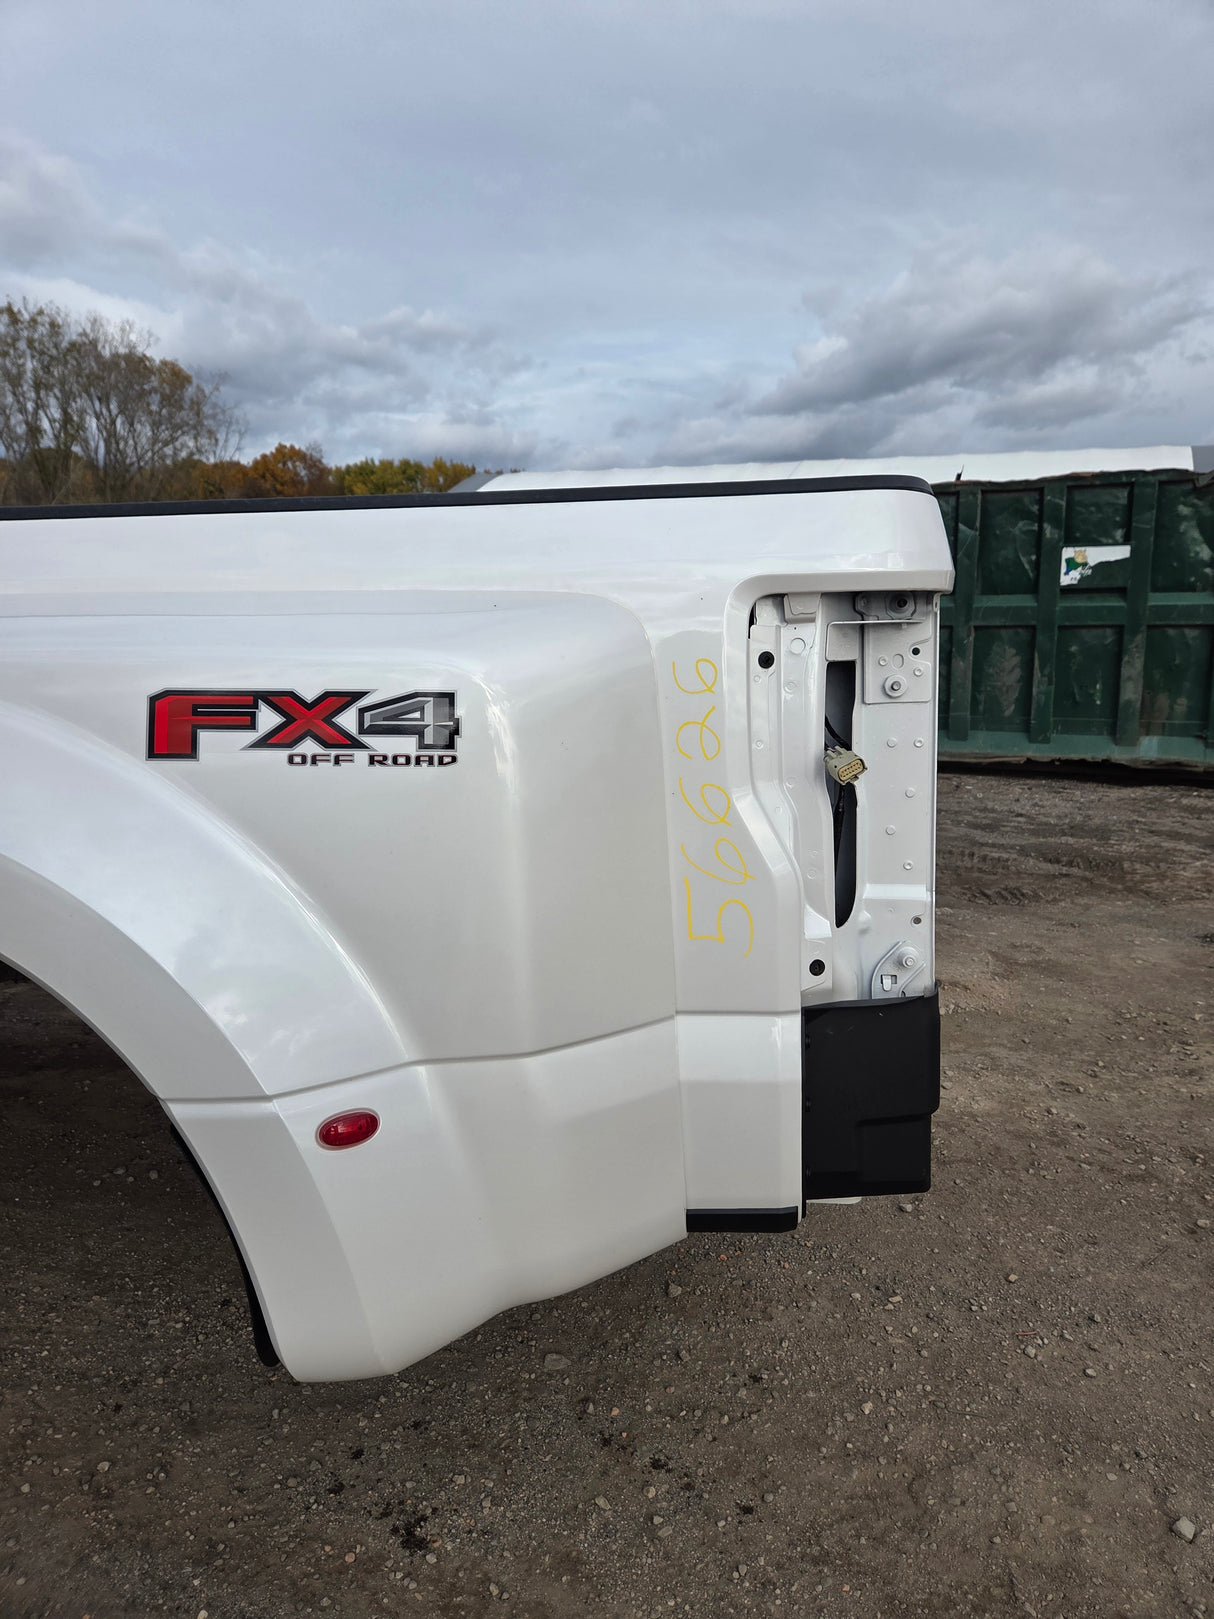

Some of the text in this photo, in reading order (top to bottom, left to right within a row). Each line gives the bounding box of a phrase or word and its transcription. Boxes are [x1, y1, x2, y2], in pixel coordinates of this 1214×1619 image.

[146, 688, 461, 762] FX4
[287, 752, 458, 768] OFF ROAD
[672, 657, 757, 958] 56626
